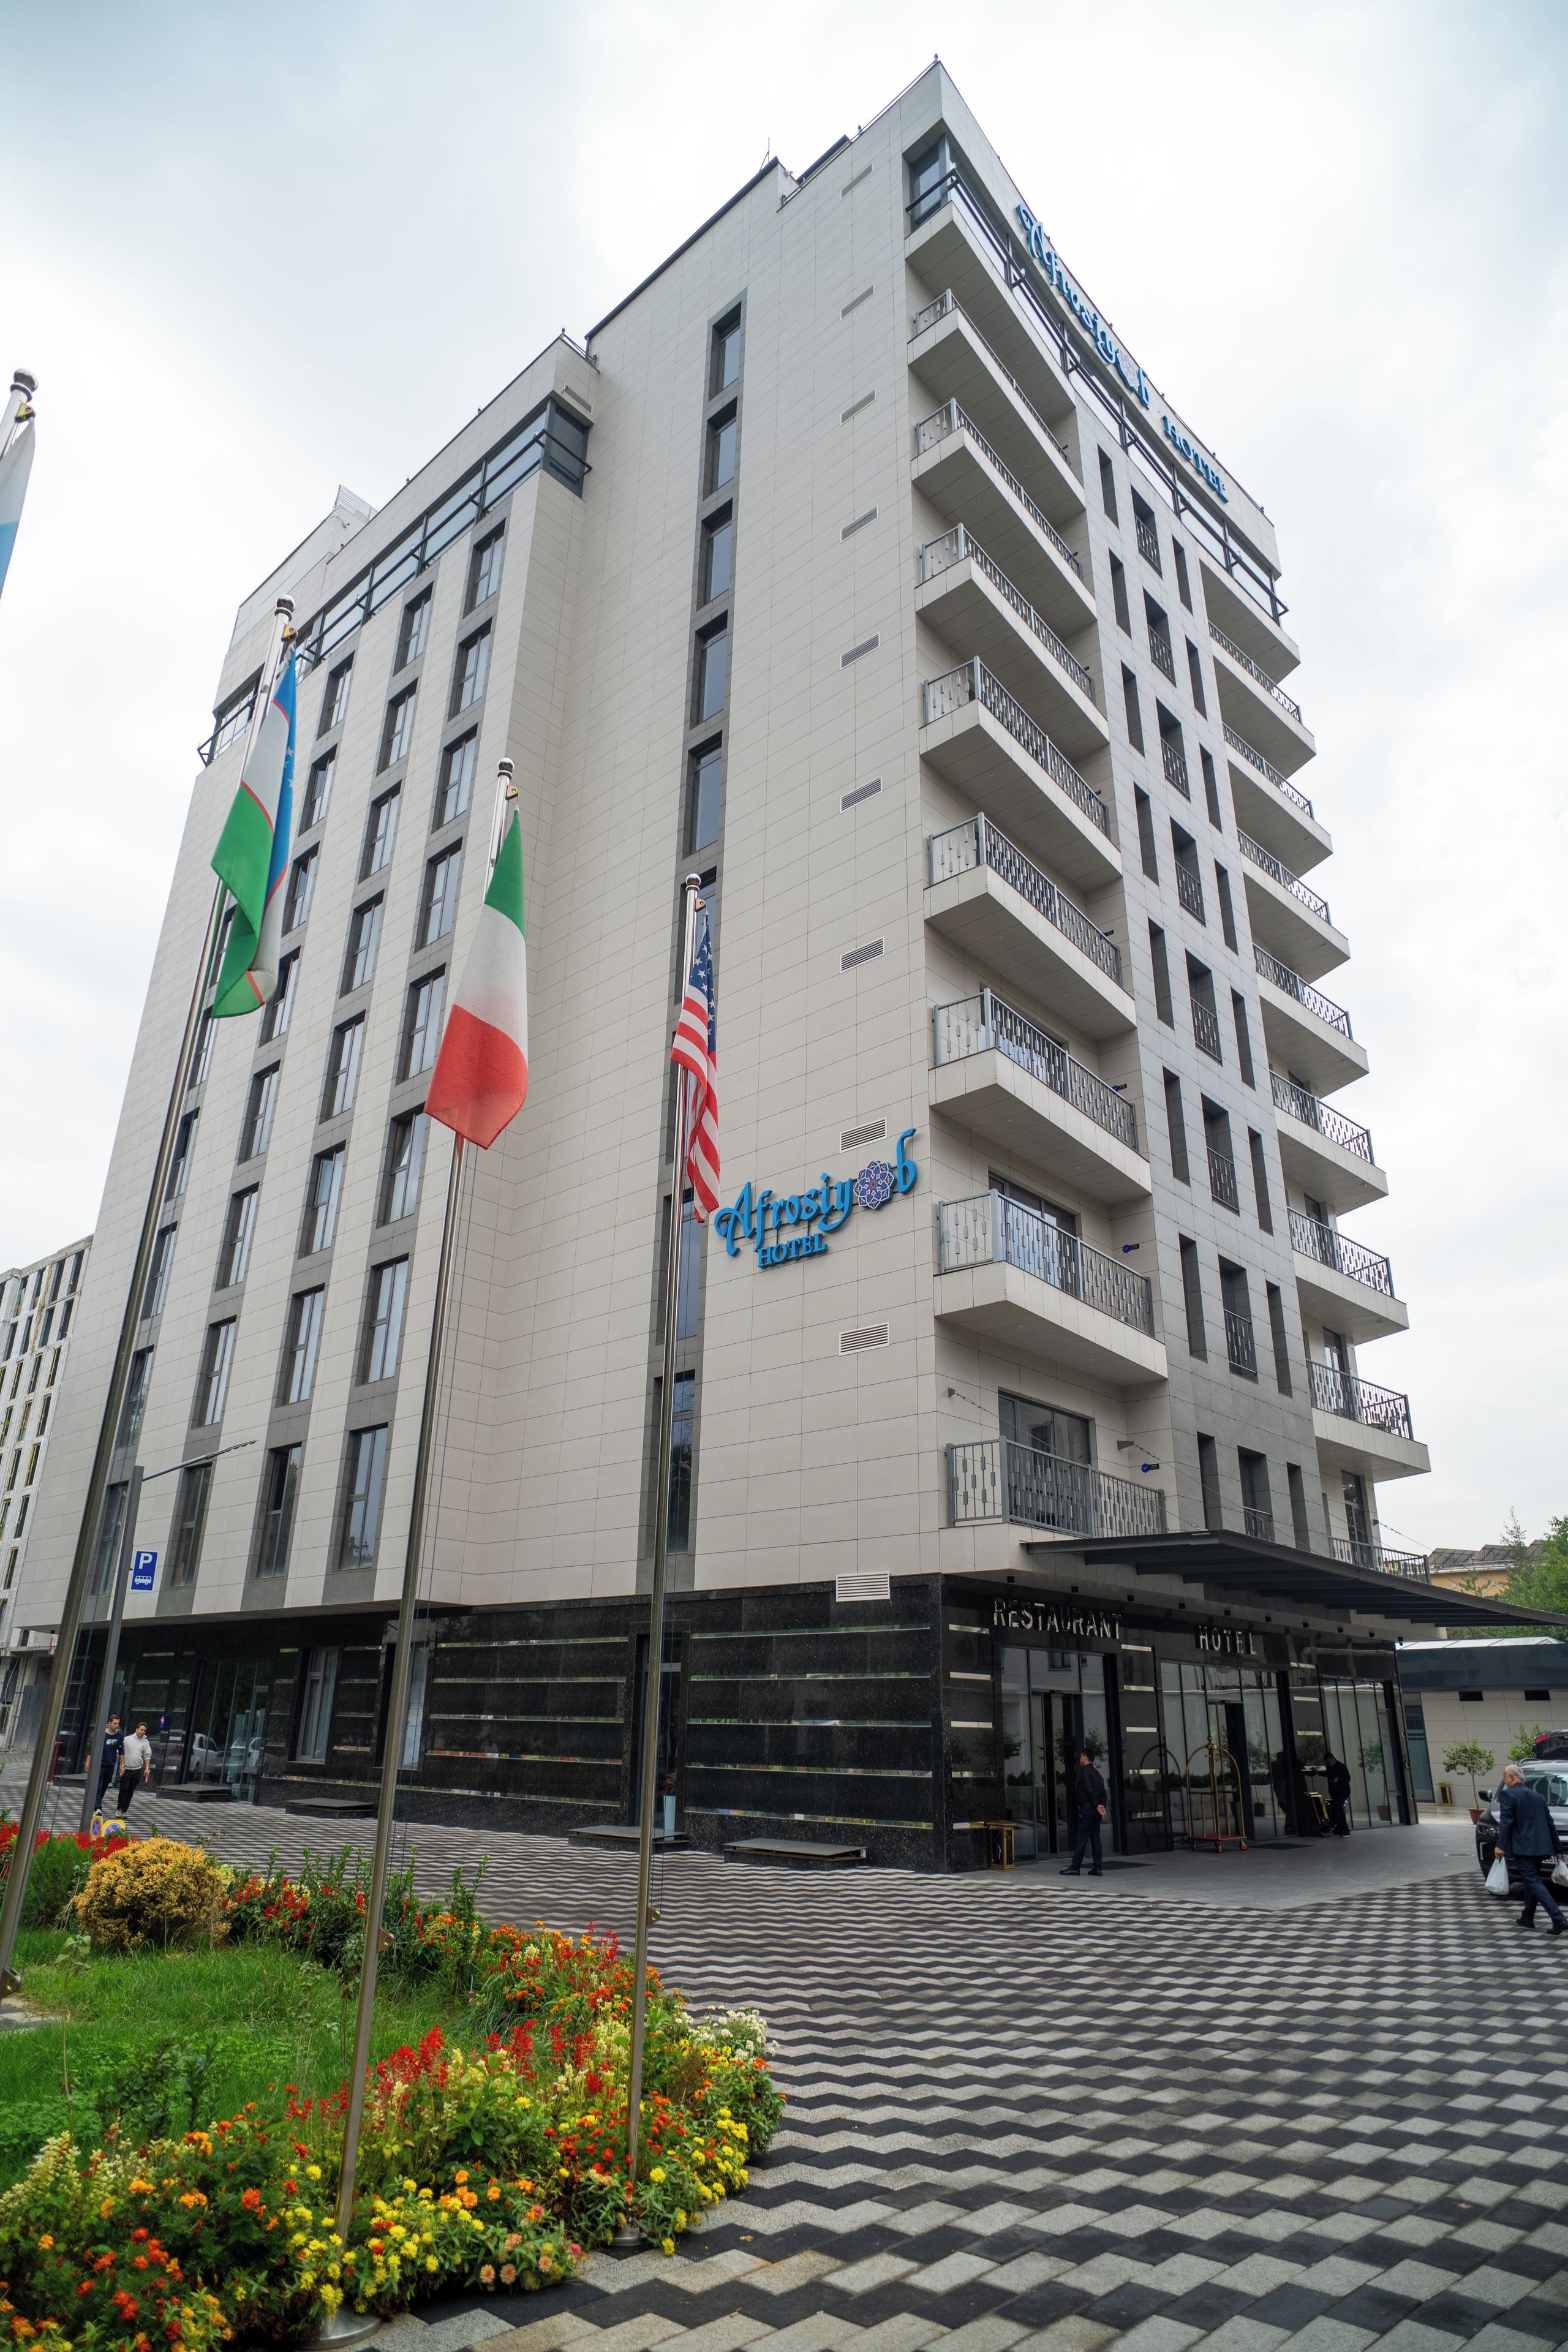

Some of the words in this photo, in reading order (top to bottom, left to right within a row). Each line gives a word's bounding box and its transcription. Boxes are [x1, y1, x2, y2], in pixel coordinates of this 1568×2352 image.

[1163, 415, 1229, 503] HOTEL
[756, 1232, 828, 1268] HOTEL
[138, 1553, 153, 1569] P
[993, 1597, 1122, 1640] RESTAURANT
[1197, 1625, 1257, 1655] HOTEL
